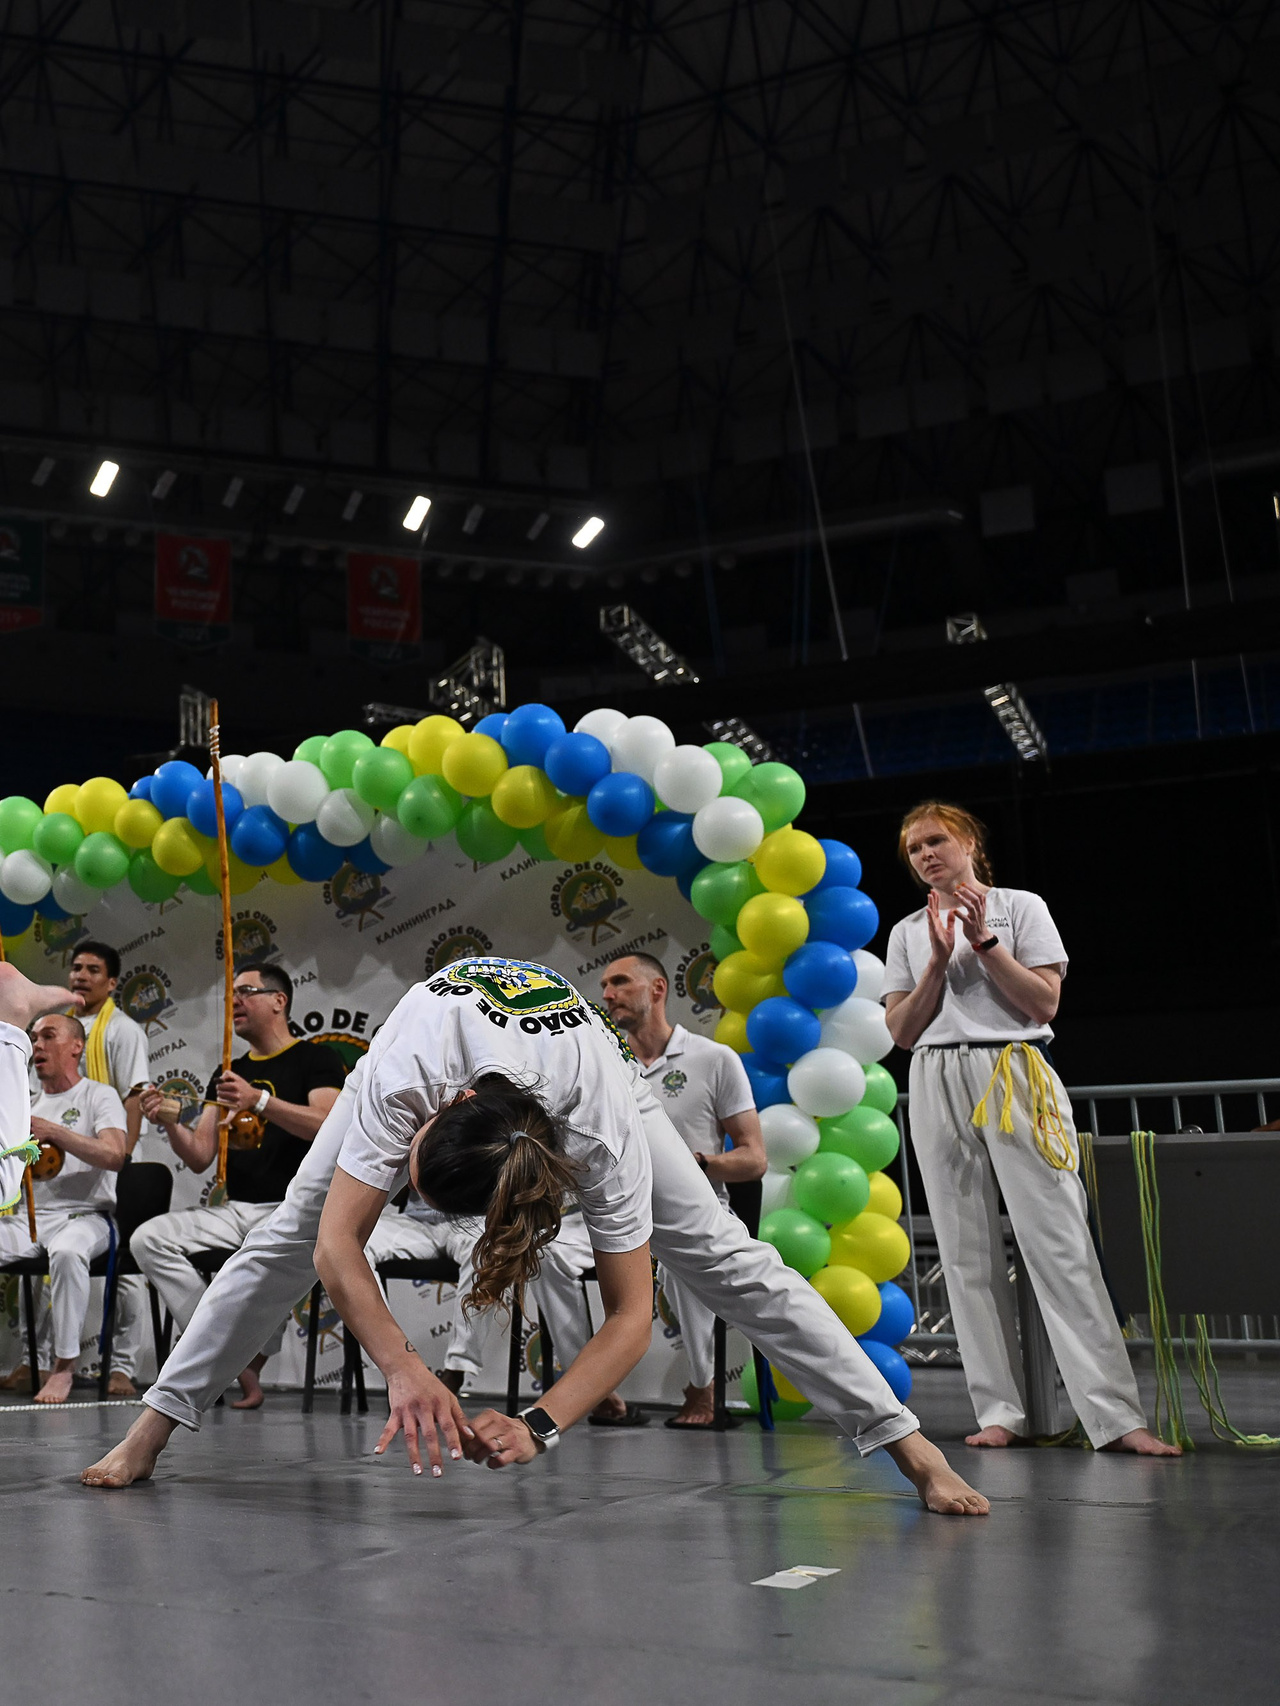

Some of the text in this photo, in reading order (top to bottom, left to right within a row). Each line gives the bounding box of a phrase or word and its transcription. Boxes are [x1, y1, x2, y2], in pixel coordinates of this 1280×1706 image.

[575, 862, 591, 871] DE
[594, 862, 624, 887] OURO
[253, 911, 277, 934] OURO
[375, 898, 456, 945] КАЛИНИНГРАД
[448, 925, 463, 937] DE
[466, 926, 493, 950] OURO
[701, 942, 710, 951] D
[134, 964, 147, 974] DE
[150, 965, 172, 988] OURO
[331, 1008, 369, 1034] DE
[475, 998, 508, 1029] DE
[148, 1038, 187, 1063] ИНГРАД
[181, 1070, 205, 1094] OURO
